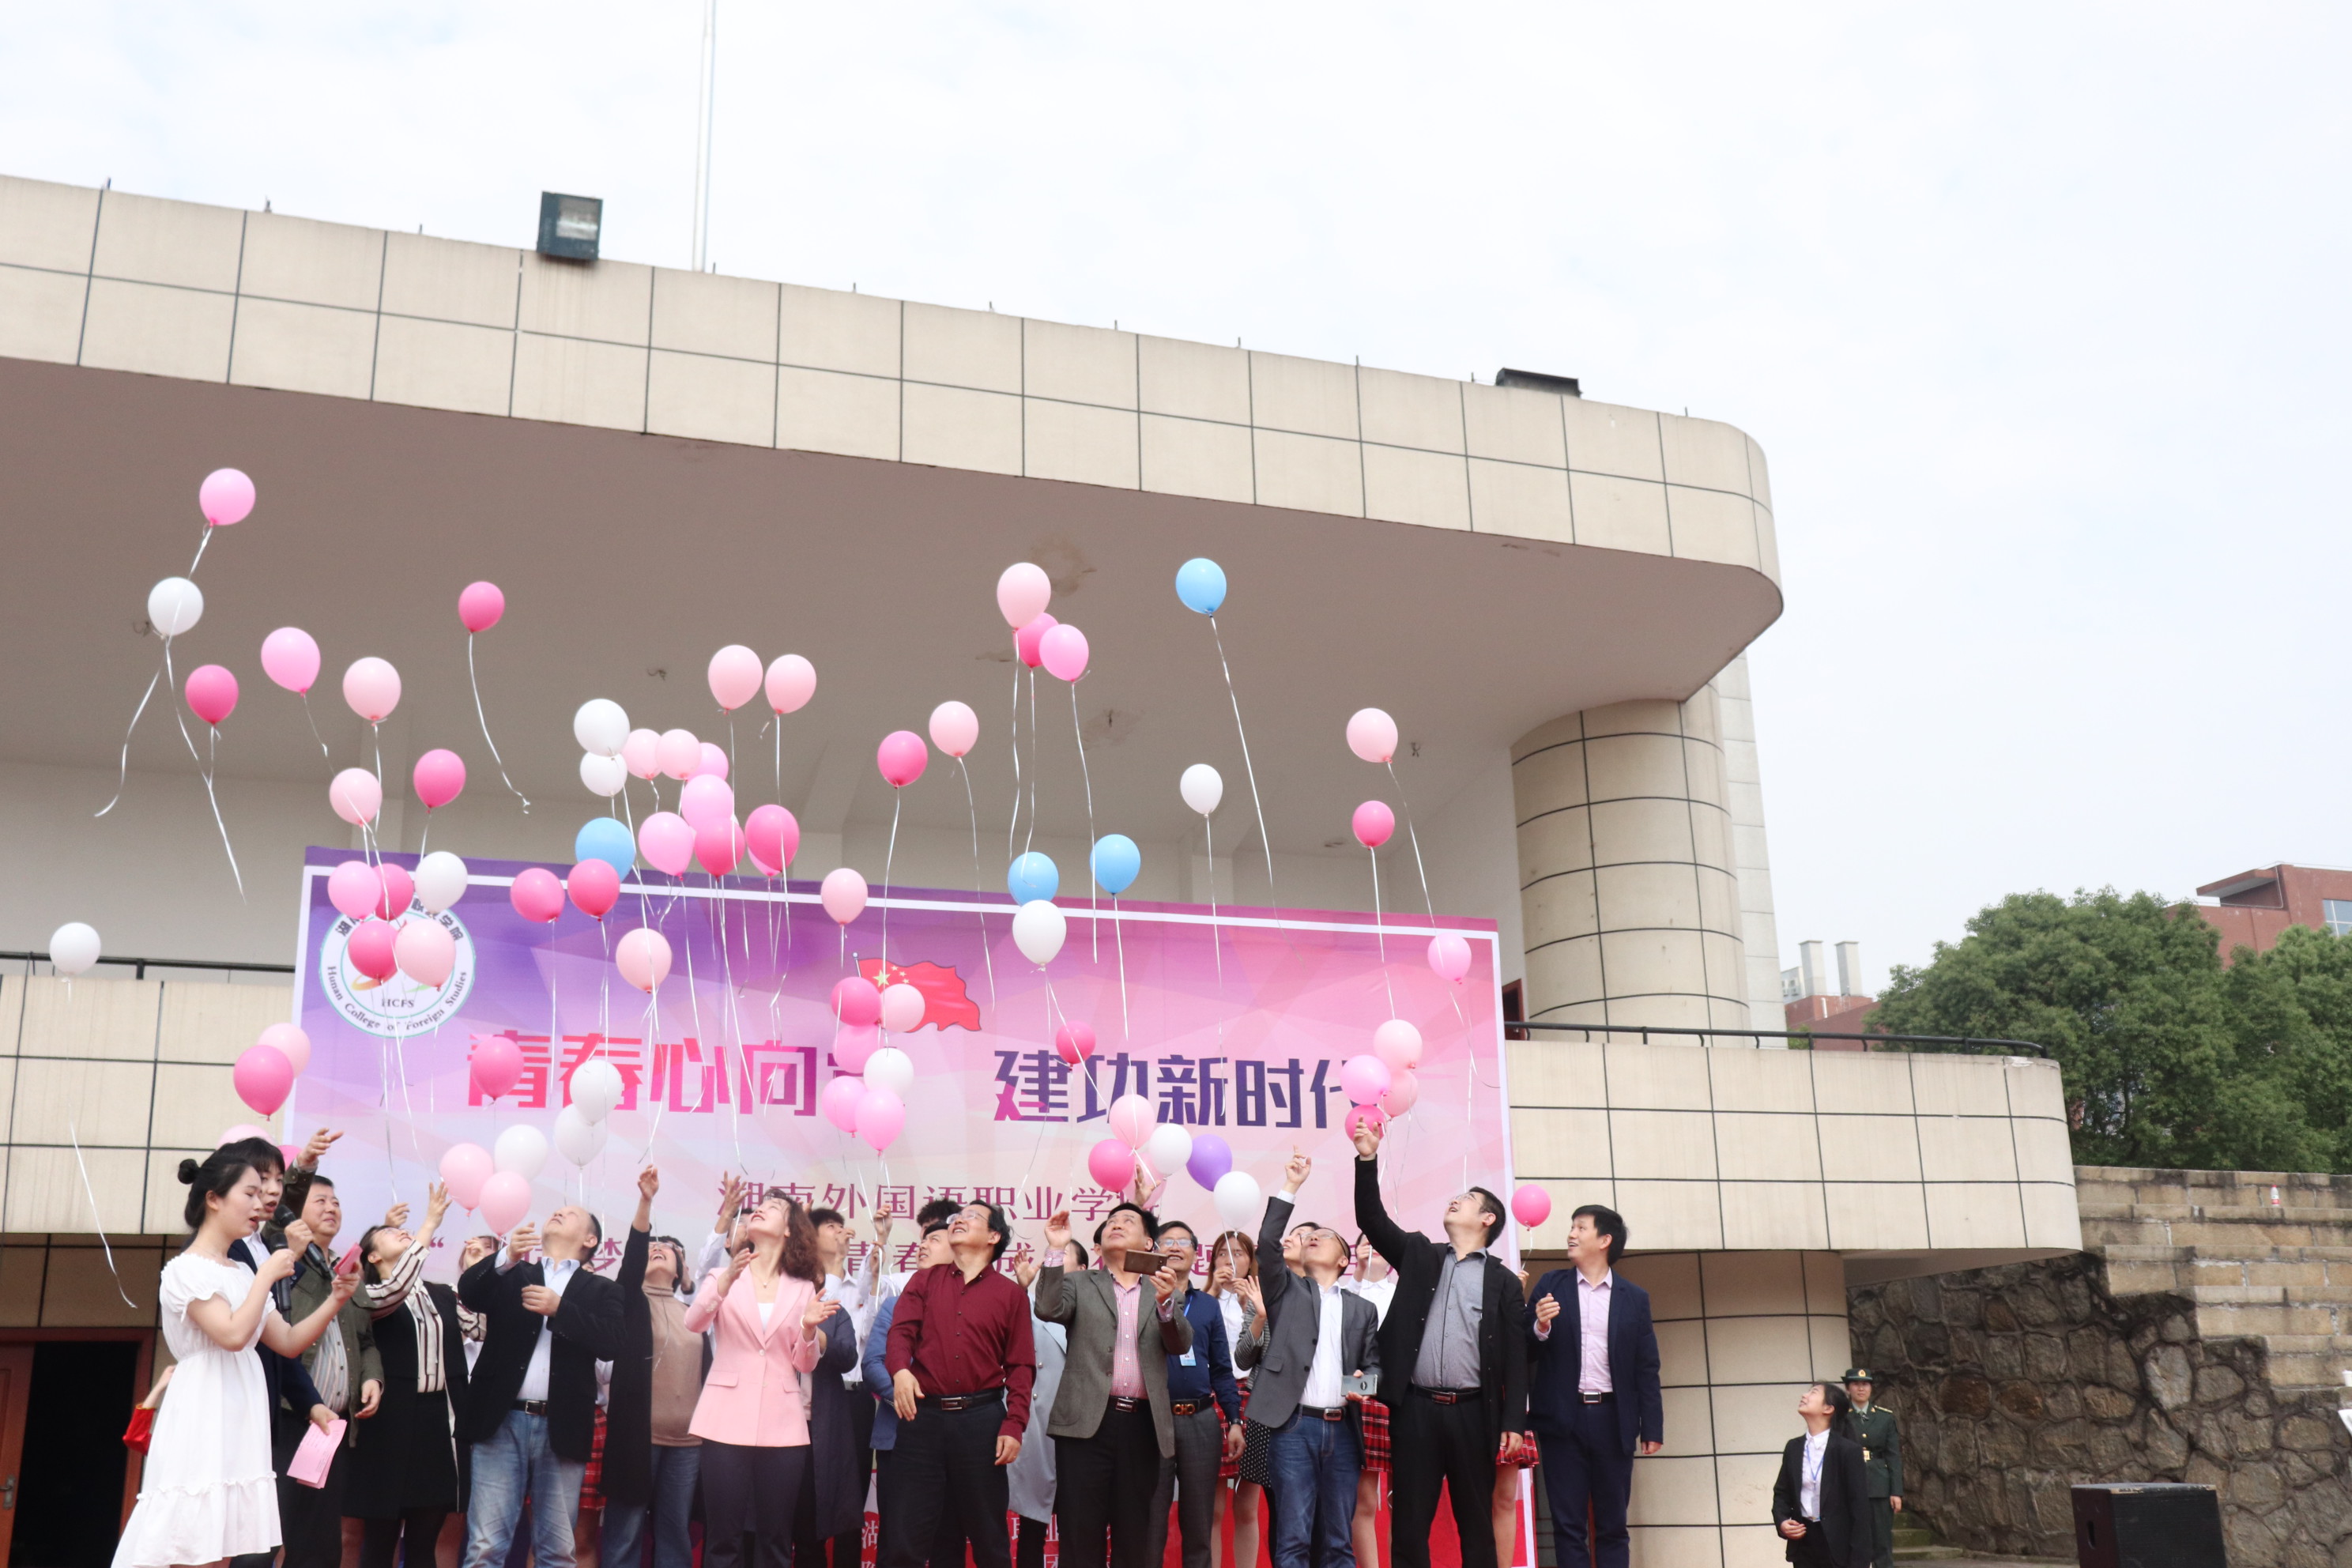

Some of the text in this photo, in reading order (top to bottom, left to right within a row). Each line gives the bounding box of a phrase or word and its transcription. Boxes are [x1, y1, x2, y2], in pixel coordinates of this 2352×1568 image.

[327, 966, 344, 1001] Hunan
[345, 1003, 381, 1028] College
[445, 971, 467, 1007] Studies
[381, 998, 415, 1008] HCFS
[467, 1030, 905, 1116] 青春心向
